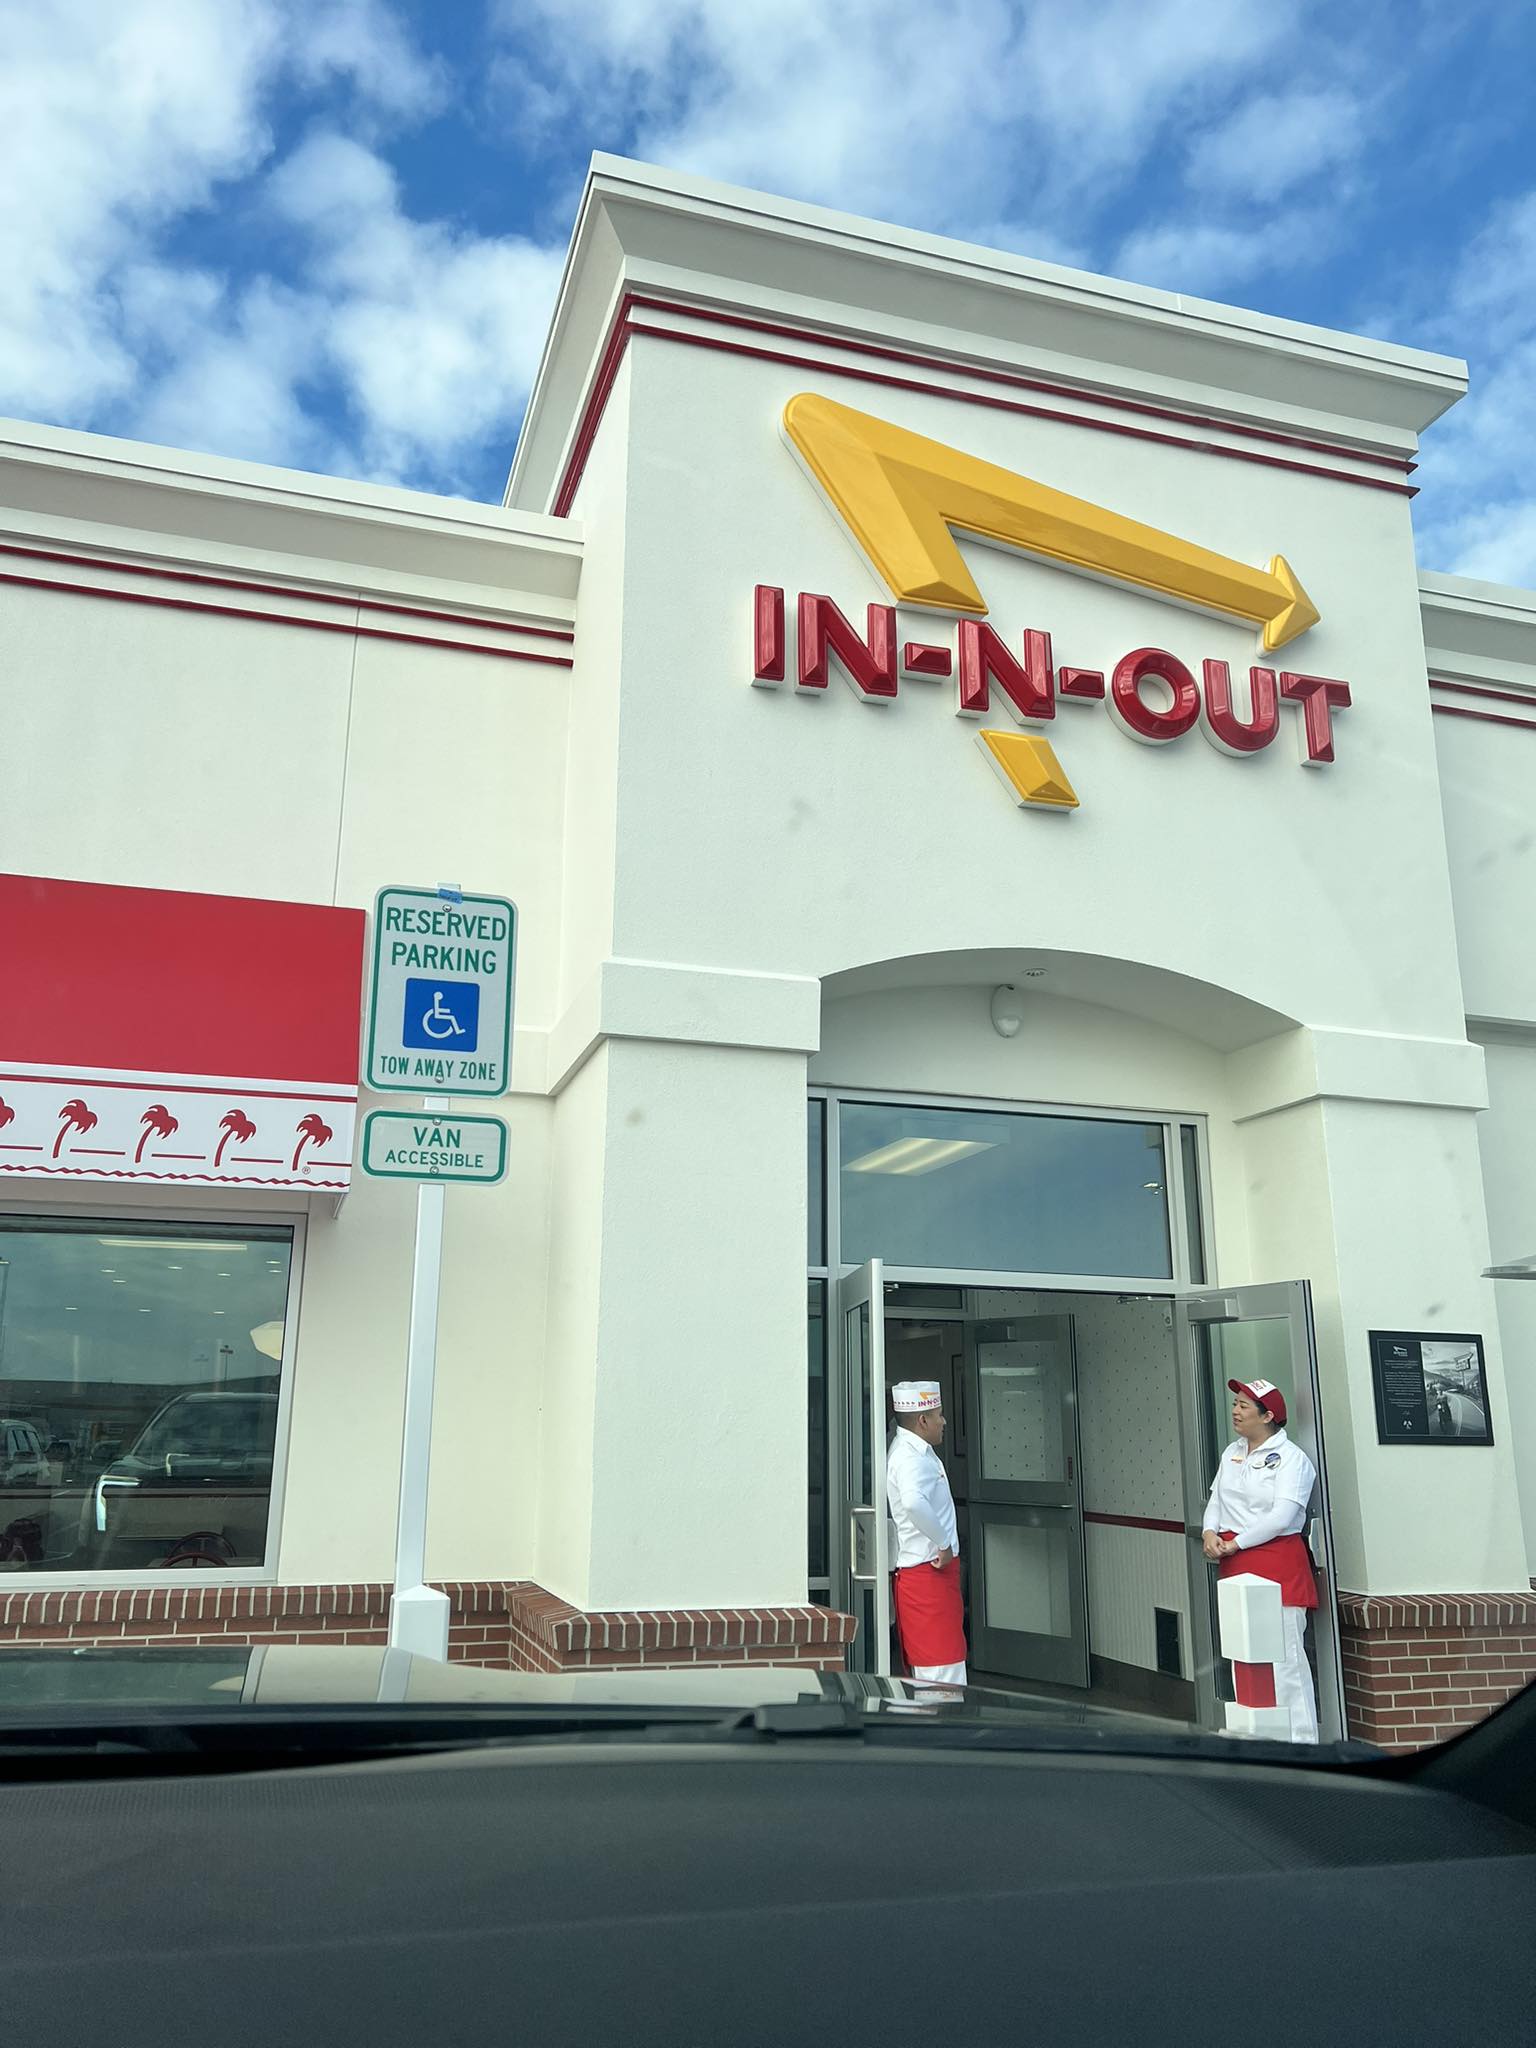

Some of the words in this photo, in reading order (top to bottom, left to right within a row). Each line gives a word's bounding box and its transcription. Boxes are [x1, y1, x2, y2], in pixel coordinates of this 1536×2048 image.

[752, 584, 1352, 766] IN-N-OUT
[385, 906, 507, 942] RESERVED
[391, 941, 497, 975] PARKING
[380, 1055, 409, 1076] TOW
[414, 1058, 455, 1079] AWAY
[459, 1061, 497, 1081] ZONE
[413, 1126, 461, 1149] VAN
[385, 1149, 484, 1169] ACCESSIBLE
